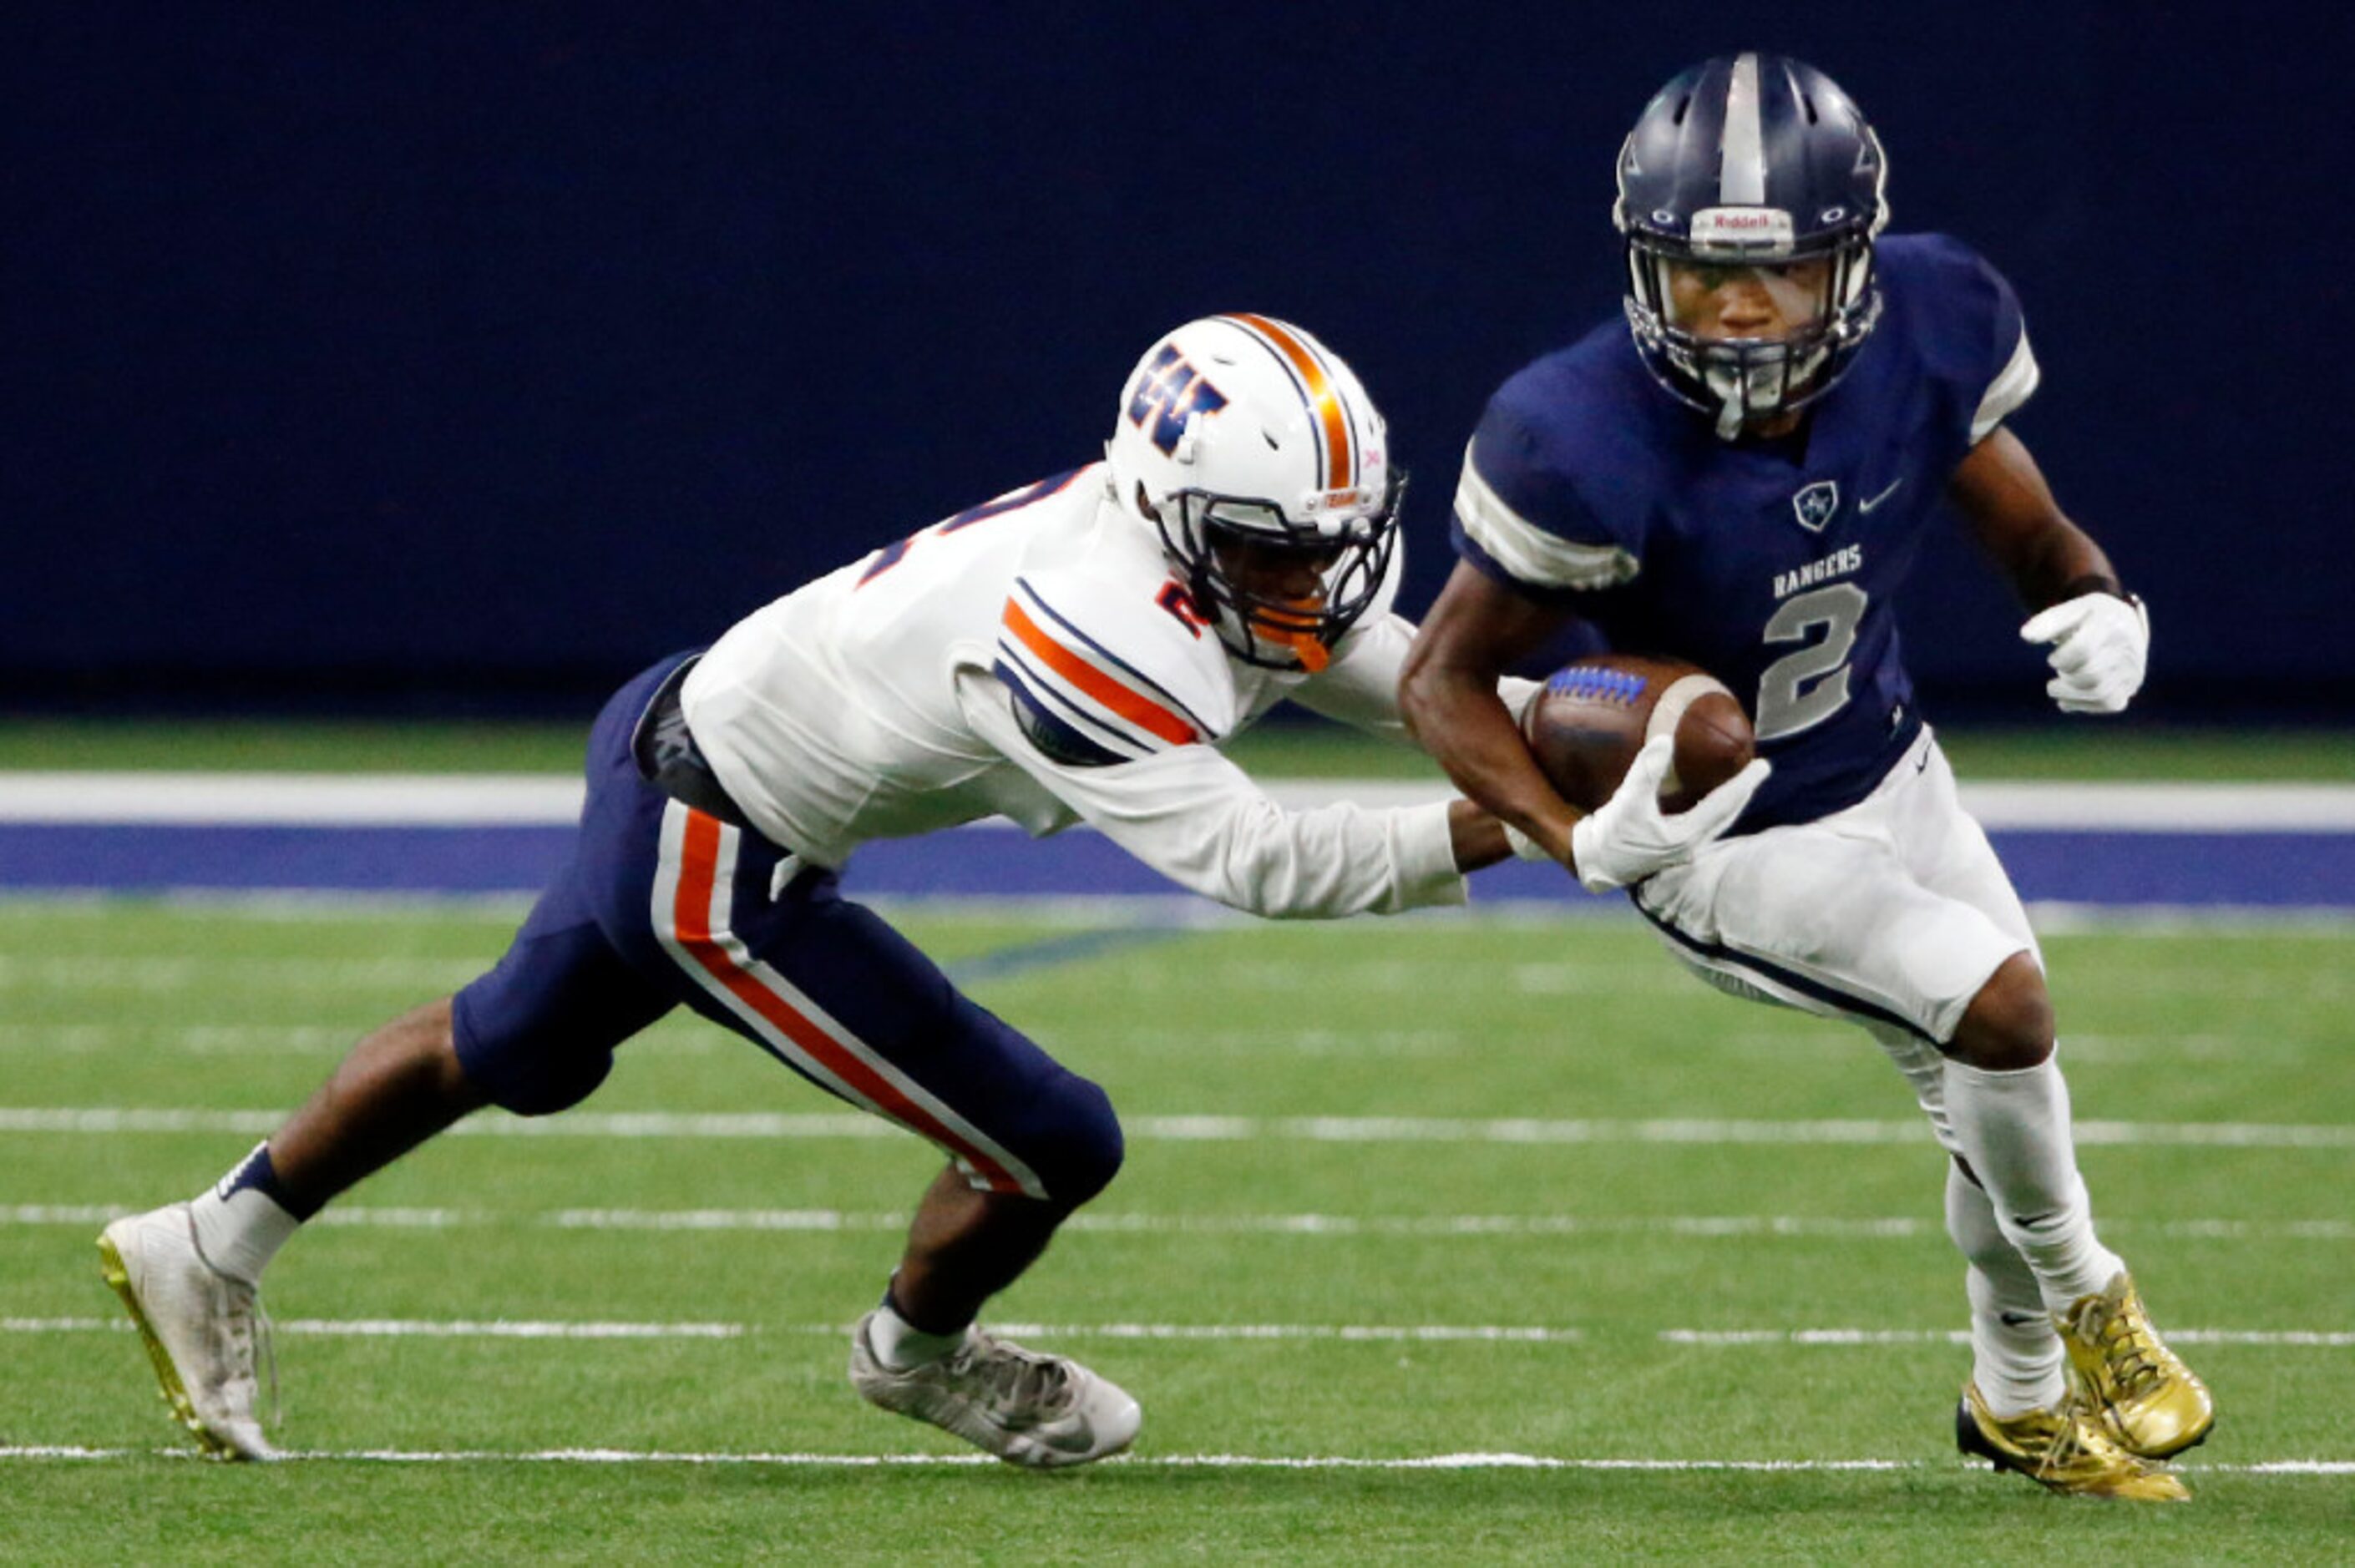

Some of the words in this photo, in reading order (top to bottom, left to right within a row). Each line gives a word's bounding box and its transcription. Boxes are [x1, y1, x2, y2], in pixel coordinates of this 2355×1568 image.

[1714, 214, 1770, 228] Riddell
[1127, 342, 1230, 460] W
[1773, 544, 1863, 599] RANGERS
[1755, 582, 1868, 741] 2
